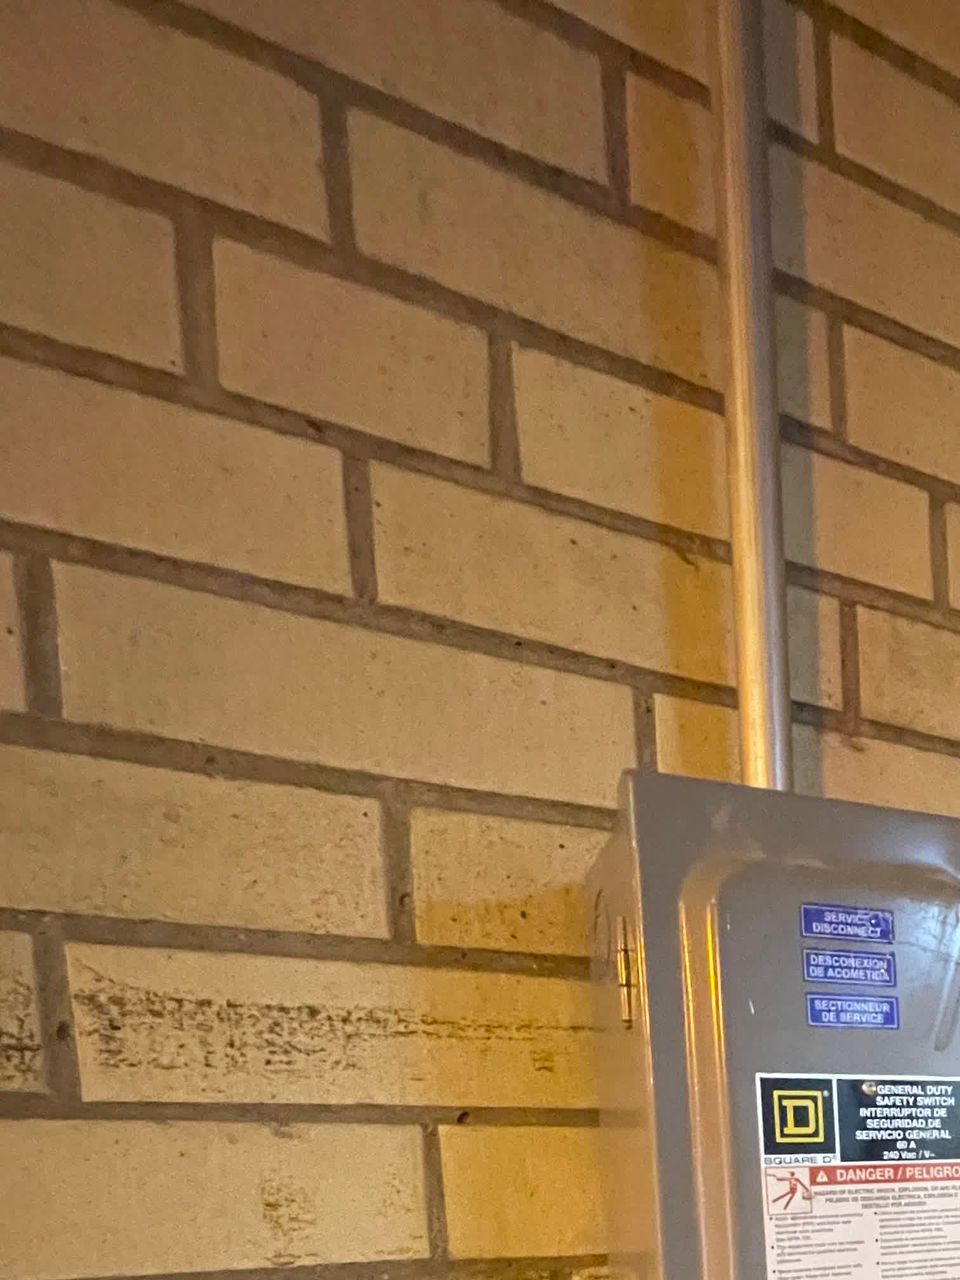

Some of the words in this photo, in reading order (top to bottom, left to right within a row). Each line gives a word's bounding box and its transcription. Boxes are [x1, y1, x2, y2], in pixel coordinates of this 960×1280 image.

[824, 911, 869, 925] SERVIC
[812, 922, 881, 937] DISCONNECT
[809, 966, 825, 977] DE
[827, 967, 890, 981] ACOMETIDA
[814, 999, 890, 1012] SECTIONNEUR
[821, 1012, 837, 1022] DE
[840, 1012, 884, 1024] SERVICE
[877, 1085, 924, 1095] GENERAL
[926, 1085, 953, 1095] DUTY
[876, 1096, 915, 1106] SAFETY
[916, 1096, 955, 1106] SWITCH
[860, 1107, 931, 1117] INTERRUPTOR
[933, 1108, 948, 1117] DE
[866, 1118, 926, 1128] SEGURIDAD
[927, 1118, 942, 1128] DE
[855, 1130, 904, 1140] SERVICIO
[905, 1129, 952, 1139] GENERAL
[908, 1140, 916, 1149] A
[764, 1156, 818, 1165] SQUARE
[836, 1166, 894, 1182] DANGER
